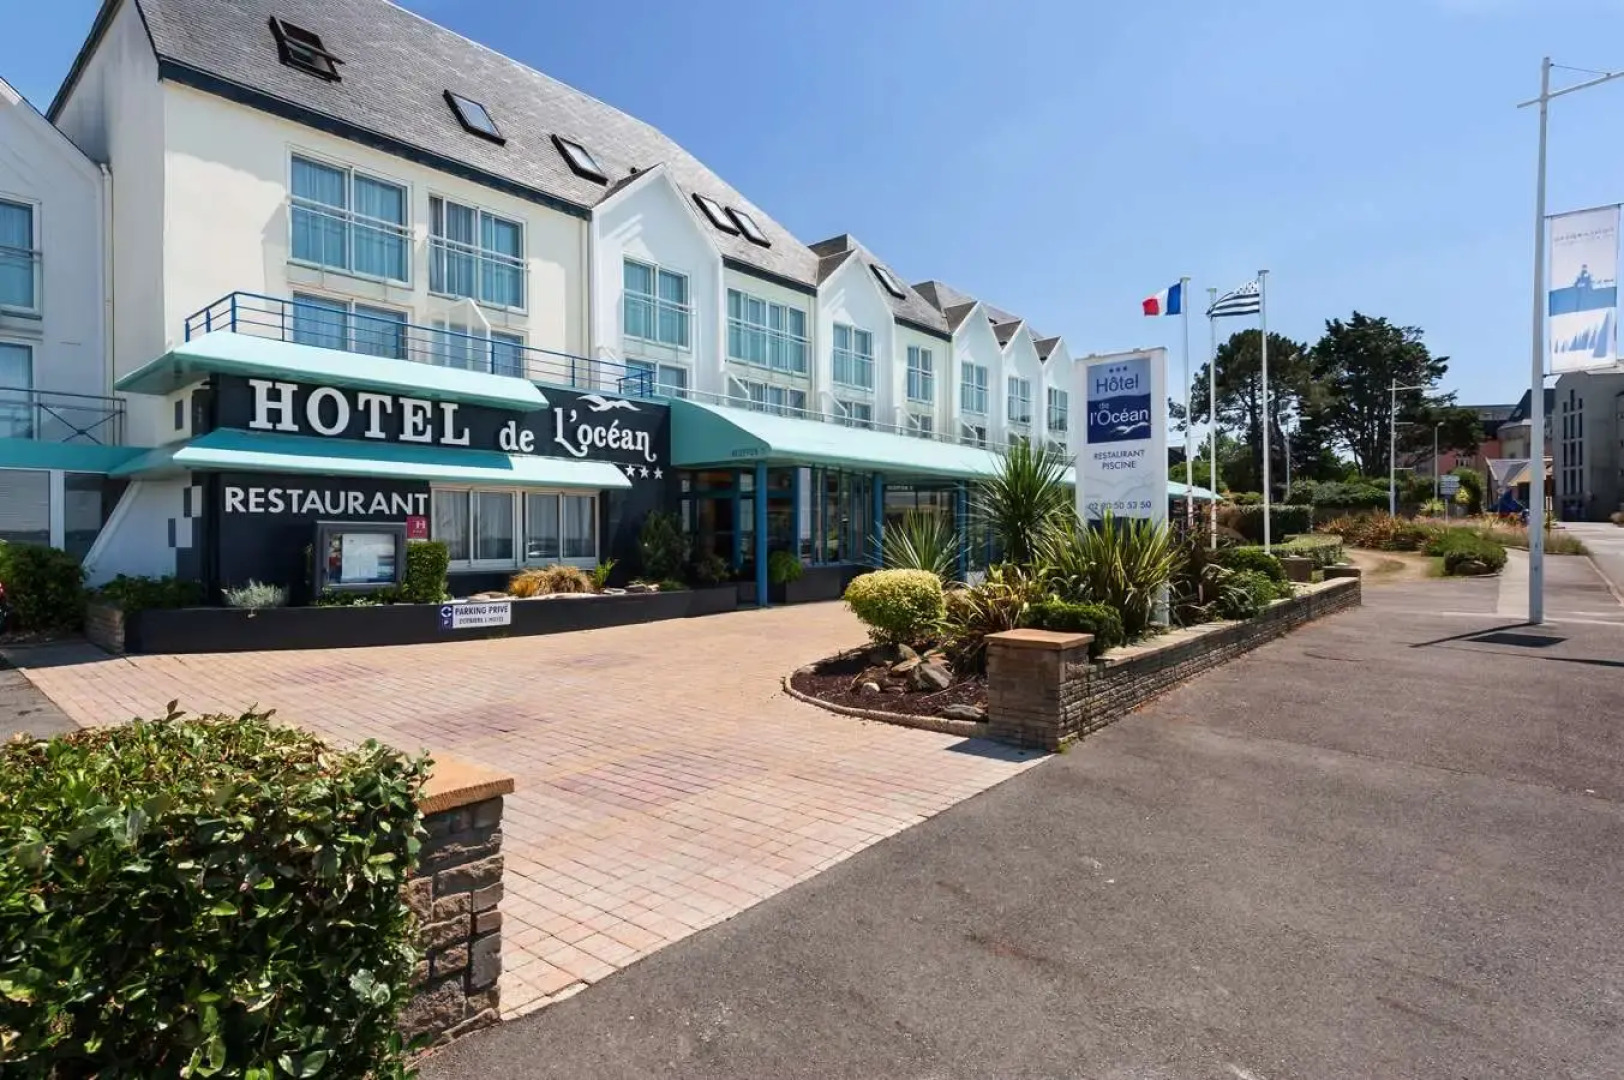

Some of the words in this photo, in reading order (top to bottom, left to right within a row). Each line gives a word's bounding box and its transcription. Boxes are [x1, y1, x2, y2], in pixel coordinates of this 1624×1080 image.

[1096, 374, 1139, 394] Hôtel
[249, 379, 470, 446] HOTEL
[500, 420, 535, 453] de
[1090, 408, 1149, 427] l'Océan
[1094, 449, 1145, 461] RESTAURANT
[1102, 461, 1137, 470] PISCINE
[224, 486, 429, 517] RESTAURANT
[455, 606, 486, 615] PARKING
